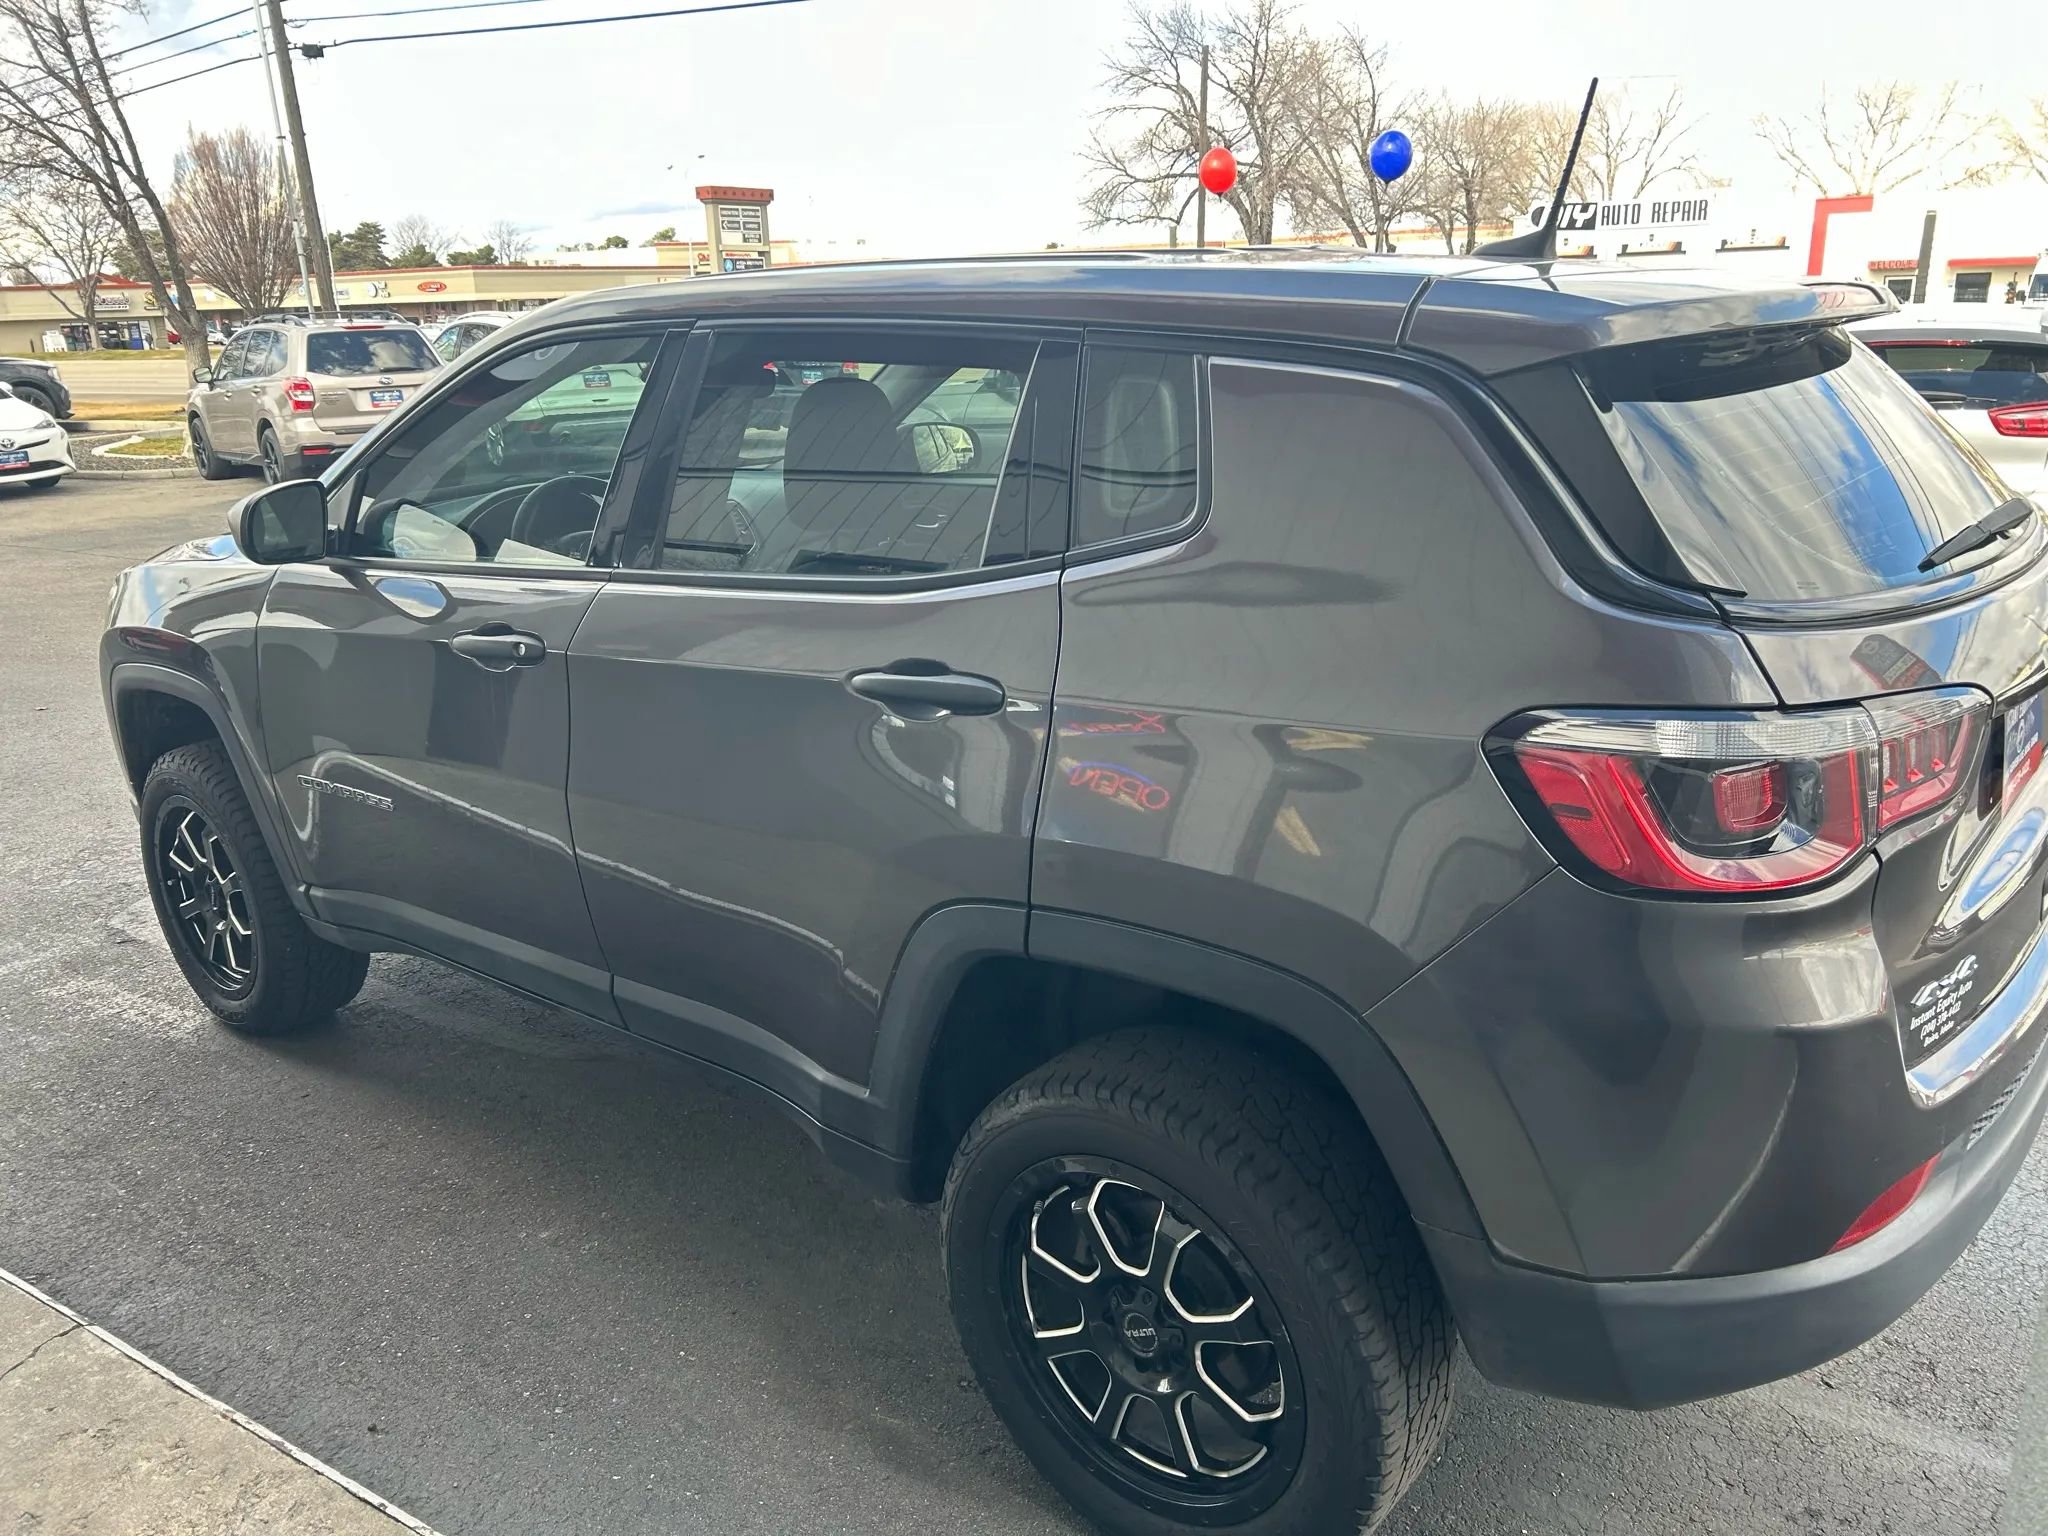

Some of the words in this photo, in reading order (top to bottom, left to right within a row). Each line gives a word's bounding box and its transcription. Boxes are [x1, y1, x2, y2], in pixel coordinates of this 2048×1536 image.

[1600, 203, 1641, 226] AUTO
[1651, 199, 1709, 223] REPAIR
[1910, 1006, 1936, 1031] Instant
[1936, 991, 1958, 1013] Equity
[1958, 980, 1973, 998] Auto
[1123, 1327, 1157, 1338] ULTRA
